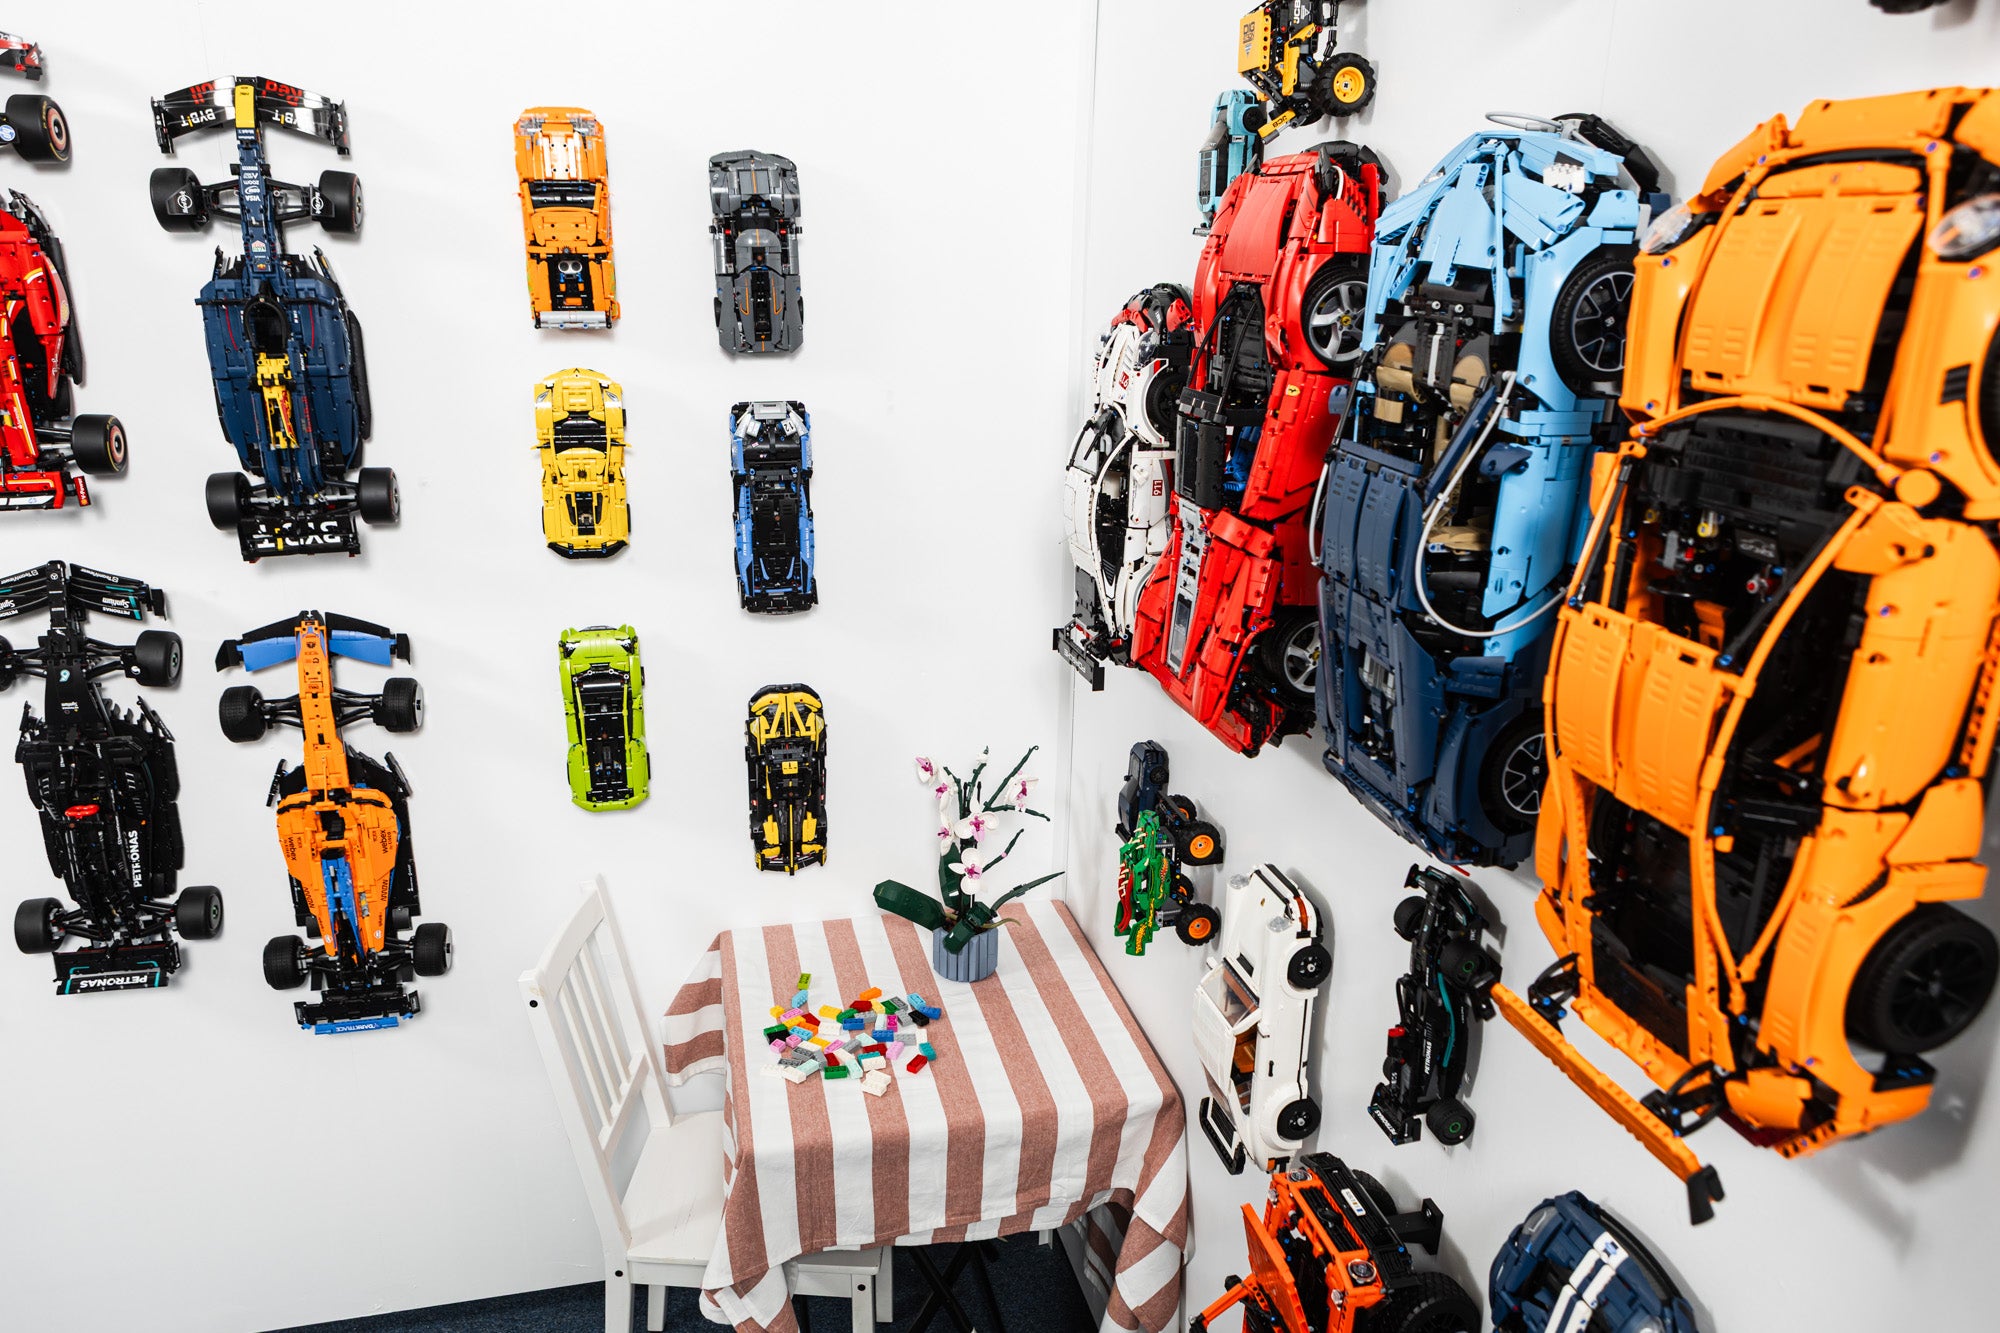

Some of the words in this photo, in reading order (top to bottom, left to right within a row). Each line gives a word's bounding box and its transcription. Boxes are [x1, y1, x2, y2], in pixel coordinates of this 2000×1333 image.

[1293, 0, 1301, 24] JCB
[1272, 115, 1288, 128] JCB
[245, 194, 261, 202] VISA
[1153, 480, 1162, 496] 911
[102, 606, 131, 616] PETRONAS
[287, 836, 298, 861] webex
[379, 829, 388, 854] webex
[128, 830, 143, 888] PETRONAS
[79, 975, 148, 989] PETRONAS
[335, 1023, 375, 1033] DARKTRACE
[1424, 1041, 1433, 1075] PETRONAS
